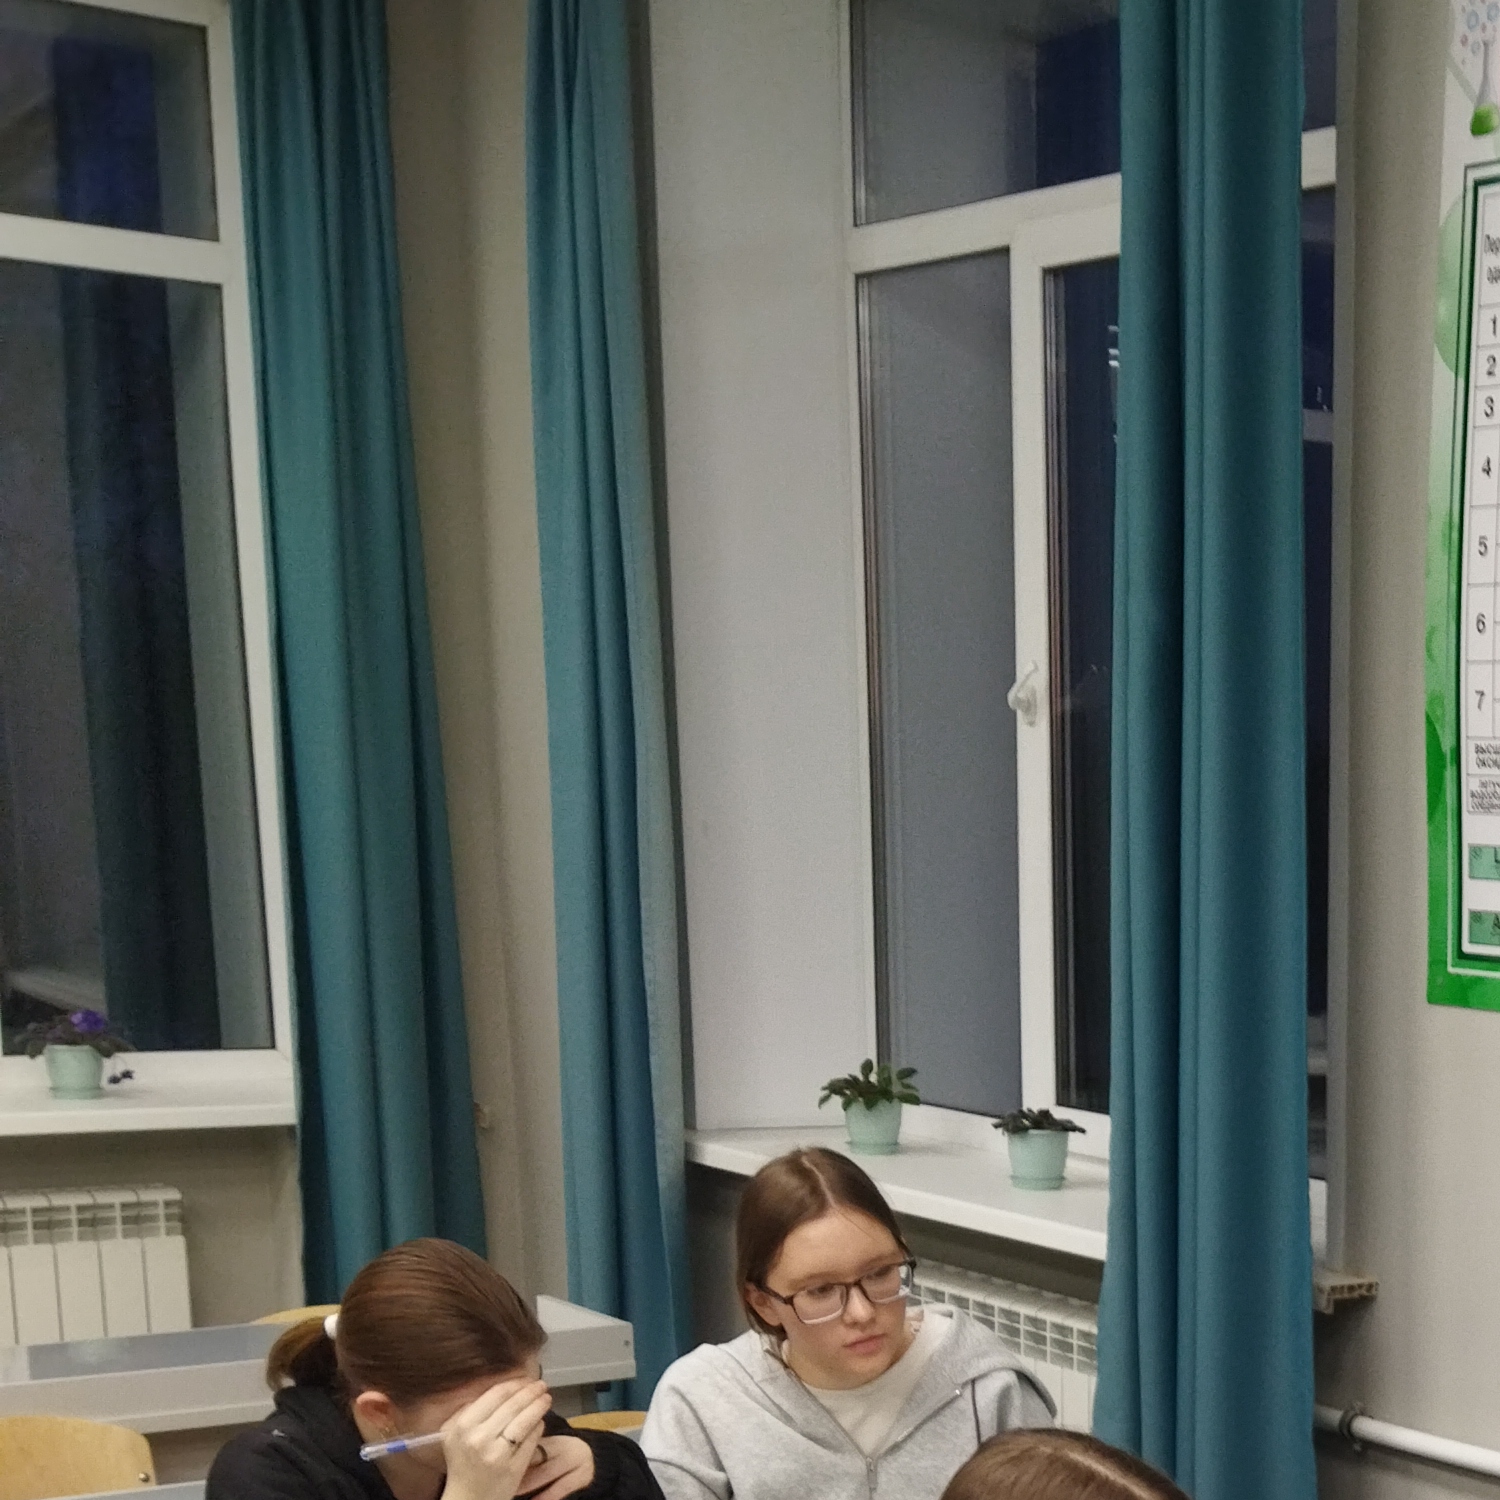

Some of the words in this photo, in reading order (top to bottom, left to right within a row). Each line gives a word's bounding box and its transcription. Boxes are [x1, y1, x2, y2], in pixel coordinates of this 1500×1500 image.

[1491, 314, 1497, 337] 1
[1487, 355, 1497, 377] 2
[1484, 396, 1494, 419] 3
[1482, 456, 1491, 478] 4
[1478, 535, 1489, 557] 5
[1476, 613, 1486, 634] 6
[1475, 689, 1486, 711] 7
